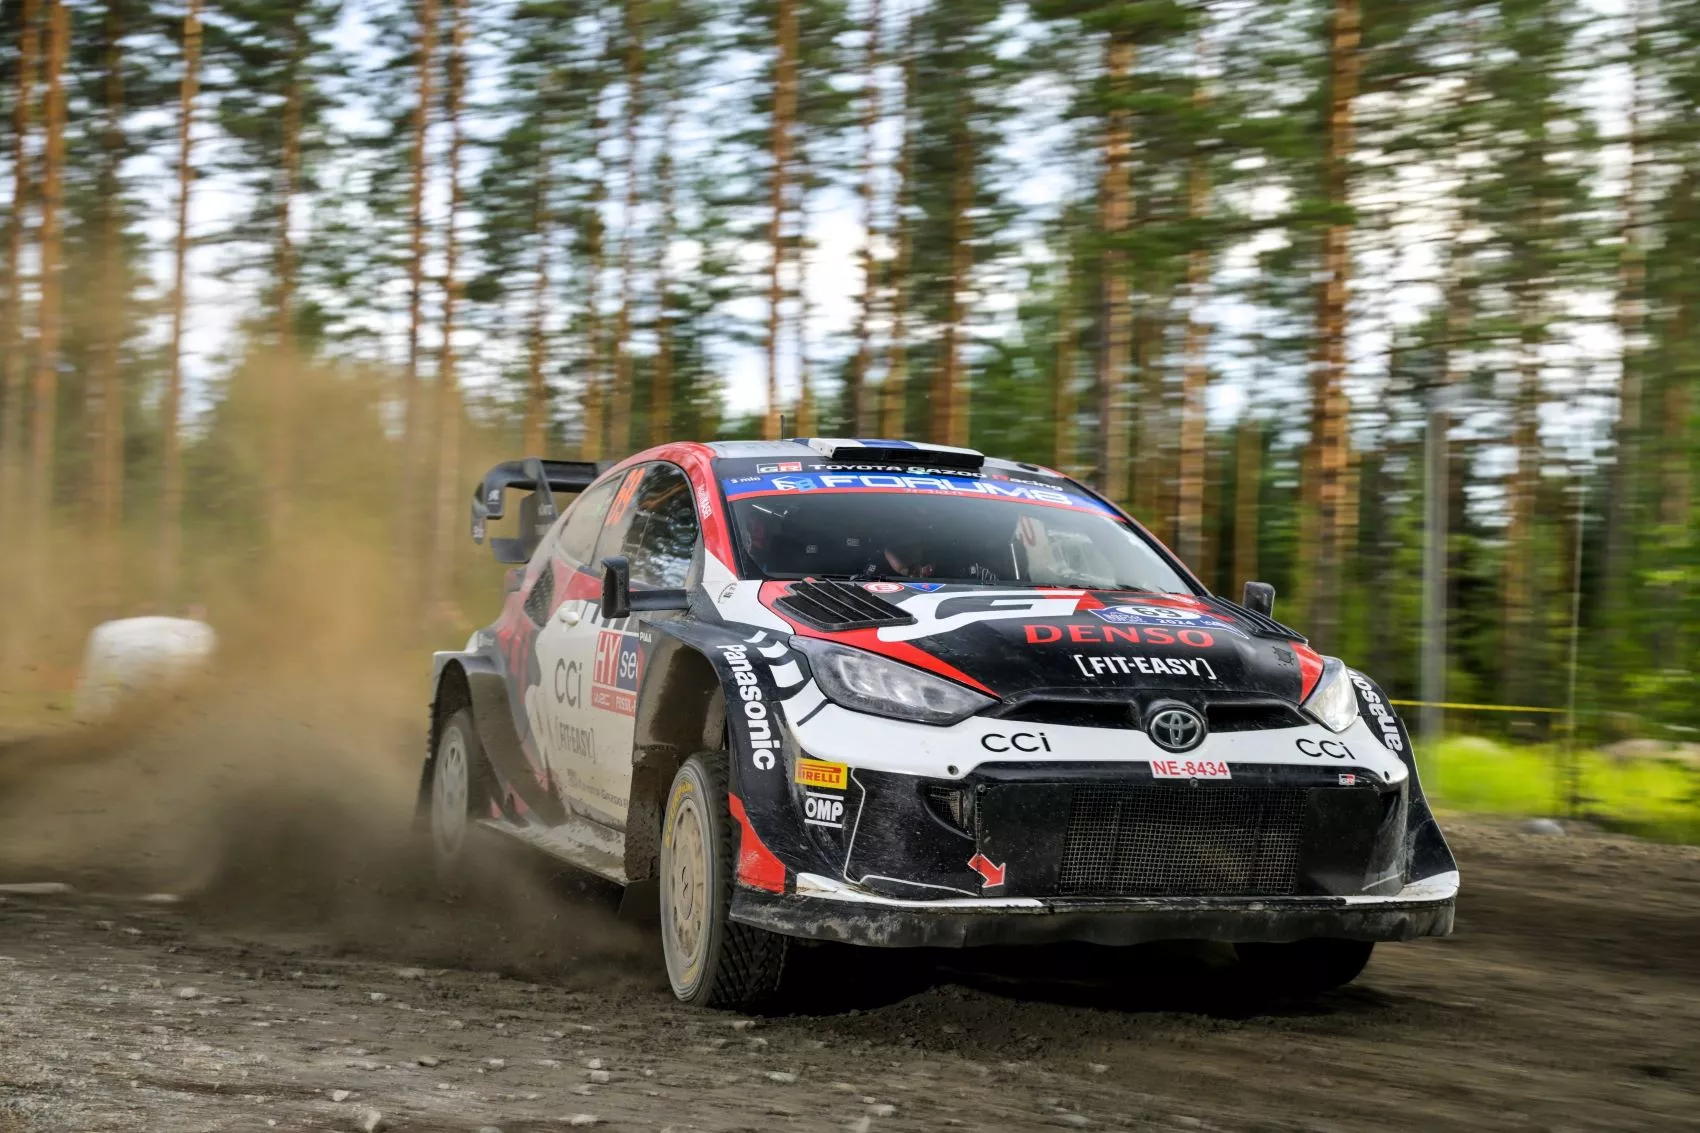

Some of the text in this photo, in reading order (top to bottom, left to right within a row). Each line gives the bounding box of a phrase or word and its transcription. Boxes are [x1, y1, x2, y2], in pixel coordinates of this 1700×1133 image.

[758, 463, 1063, 492] GR TOYOTA GAZOO Racing
[819, 475, 1073, 505] FORUM8
[1132, 606, 1183, 618] 69
[1156, 618, 1195, 626] 2024
[1023, 624, 1215, 648] DENSO
[594, 631, 638, 684] HY se
[716, 644, 780, 770] Panasonic
[798, 763, 842, 784] PIRELLI
[1153, 761, 1228, 776] NE-8434
[804, 797, 843, 822] OMP
